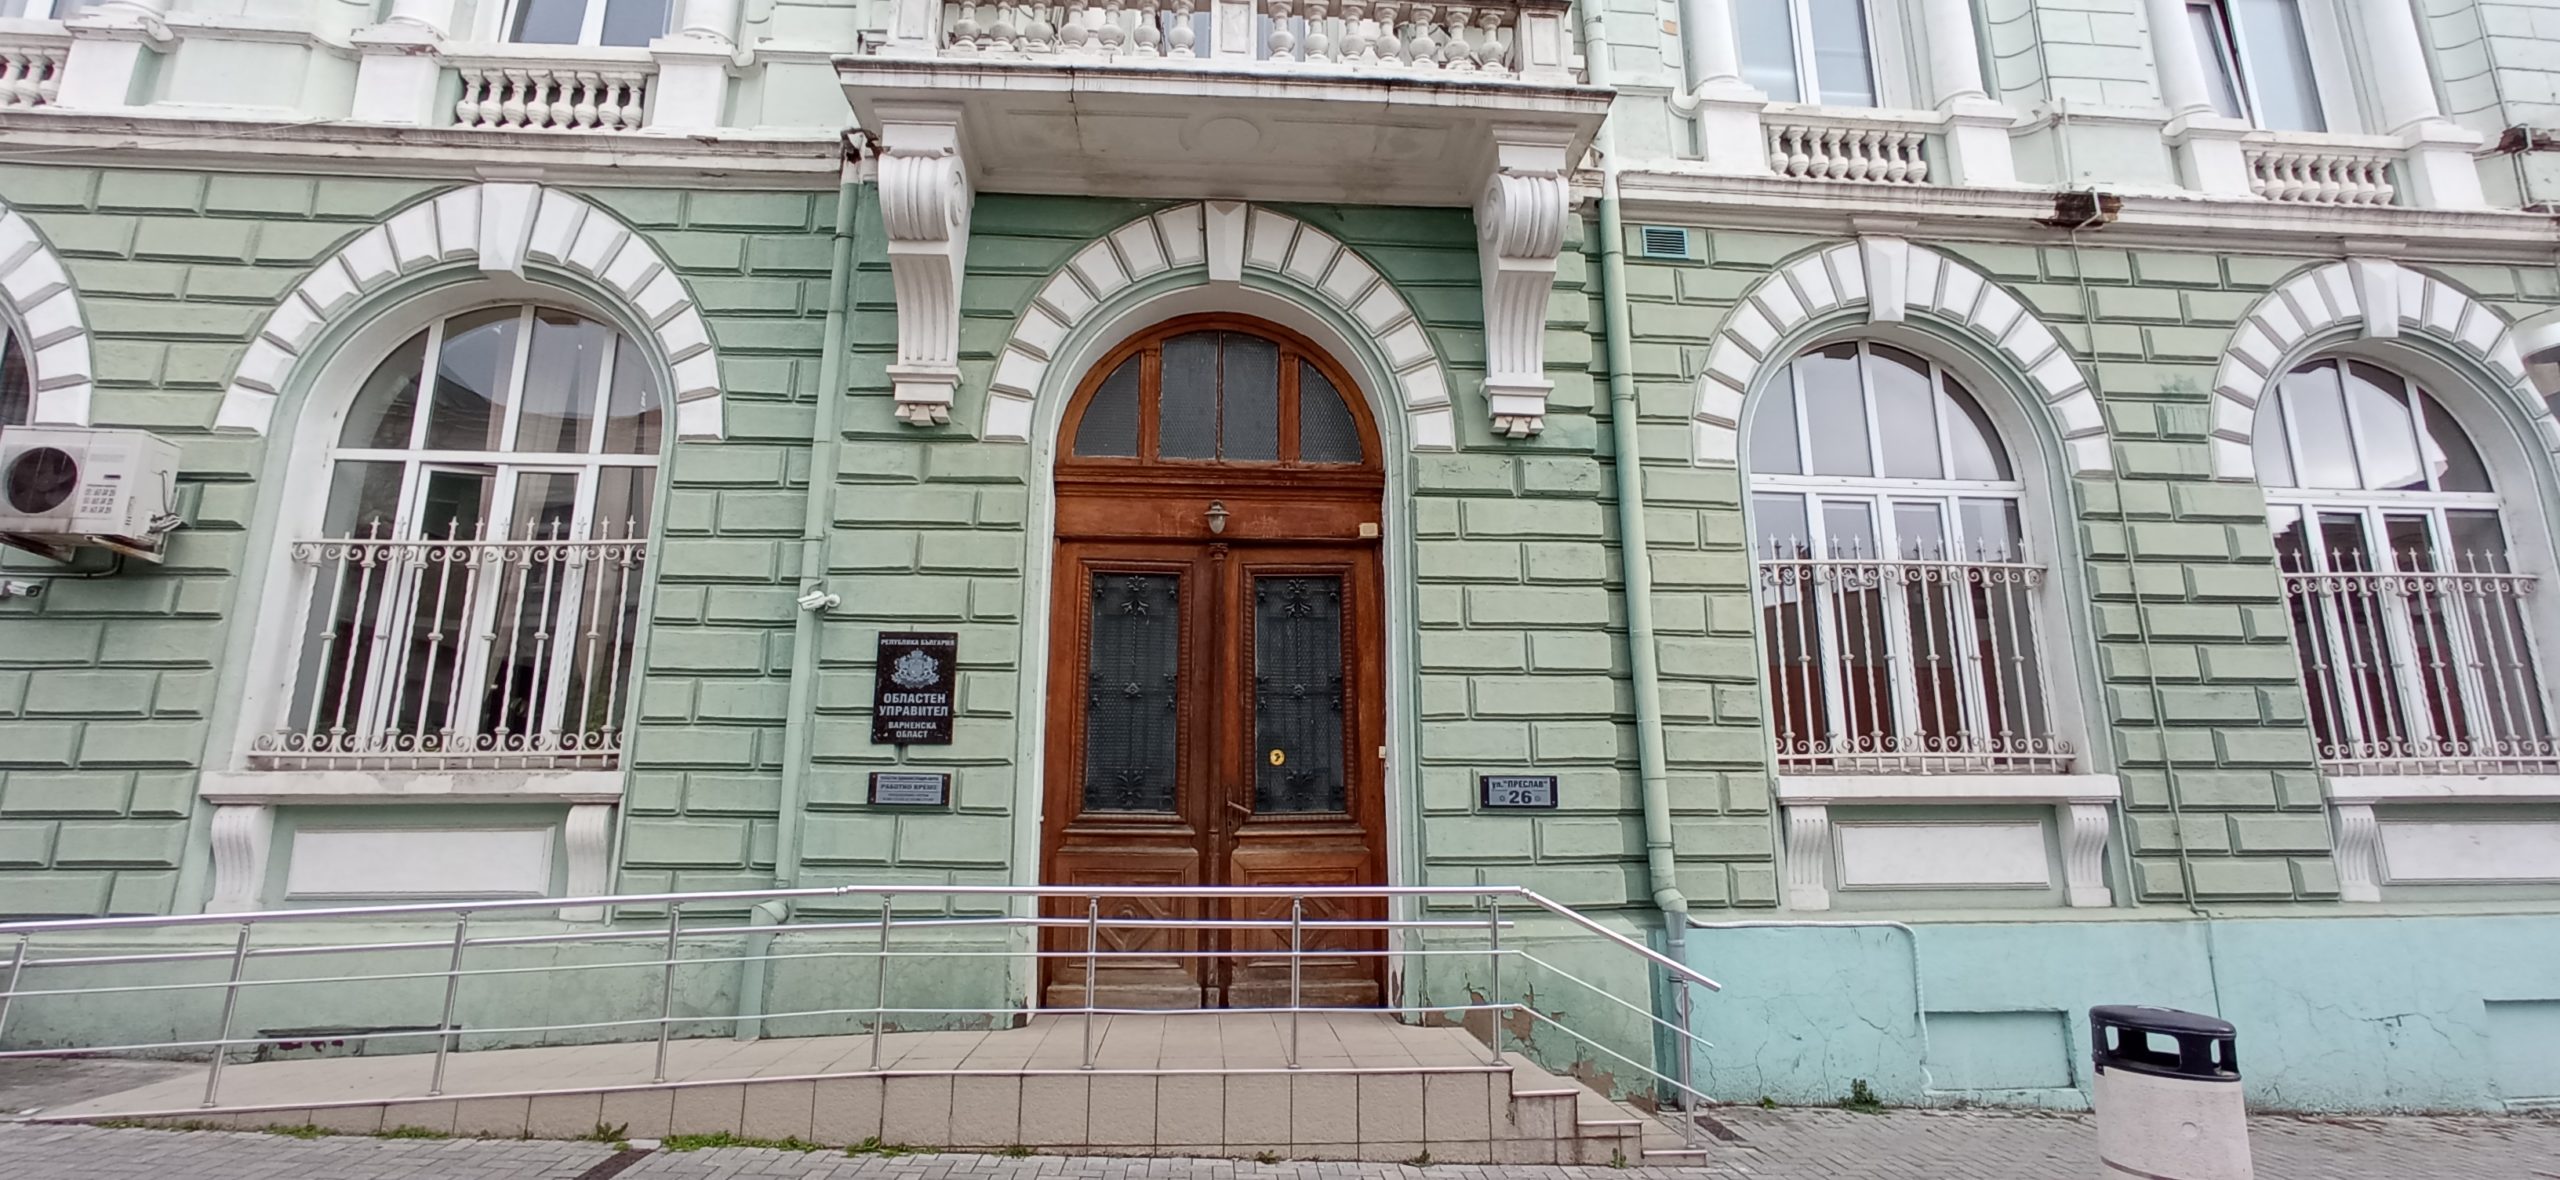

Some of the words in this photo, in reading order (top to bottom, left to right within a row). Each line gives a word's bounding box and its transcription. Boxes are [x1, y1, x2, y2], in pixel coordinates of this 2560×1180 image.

[880, 638, 919, 646] РЕПУБЛИКА
[883, 693, 946, 704] ОБЛАСТЕН
[879, 705, 949, 717] УПРАВИТЕЛ
[888, 721, 937, 729] ВАРНЕНСКА
[896, 730, 929, 738] ОБЛАСТ
[1509, 790, 1532, 804] 26
